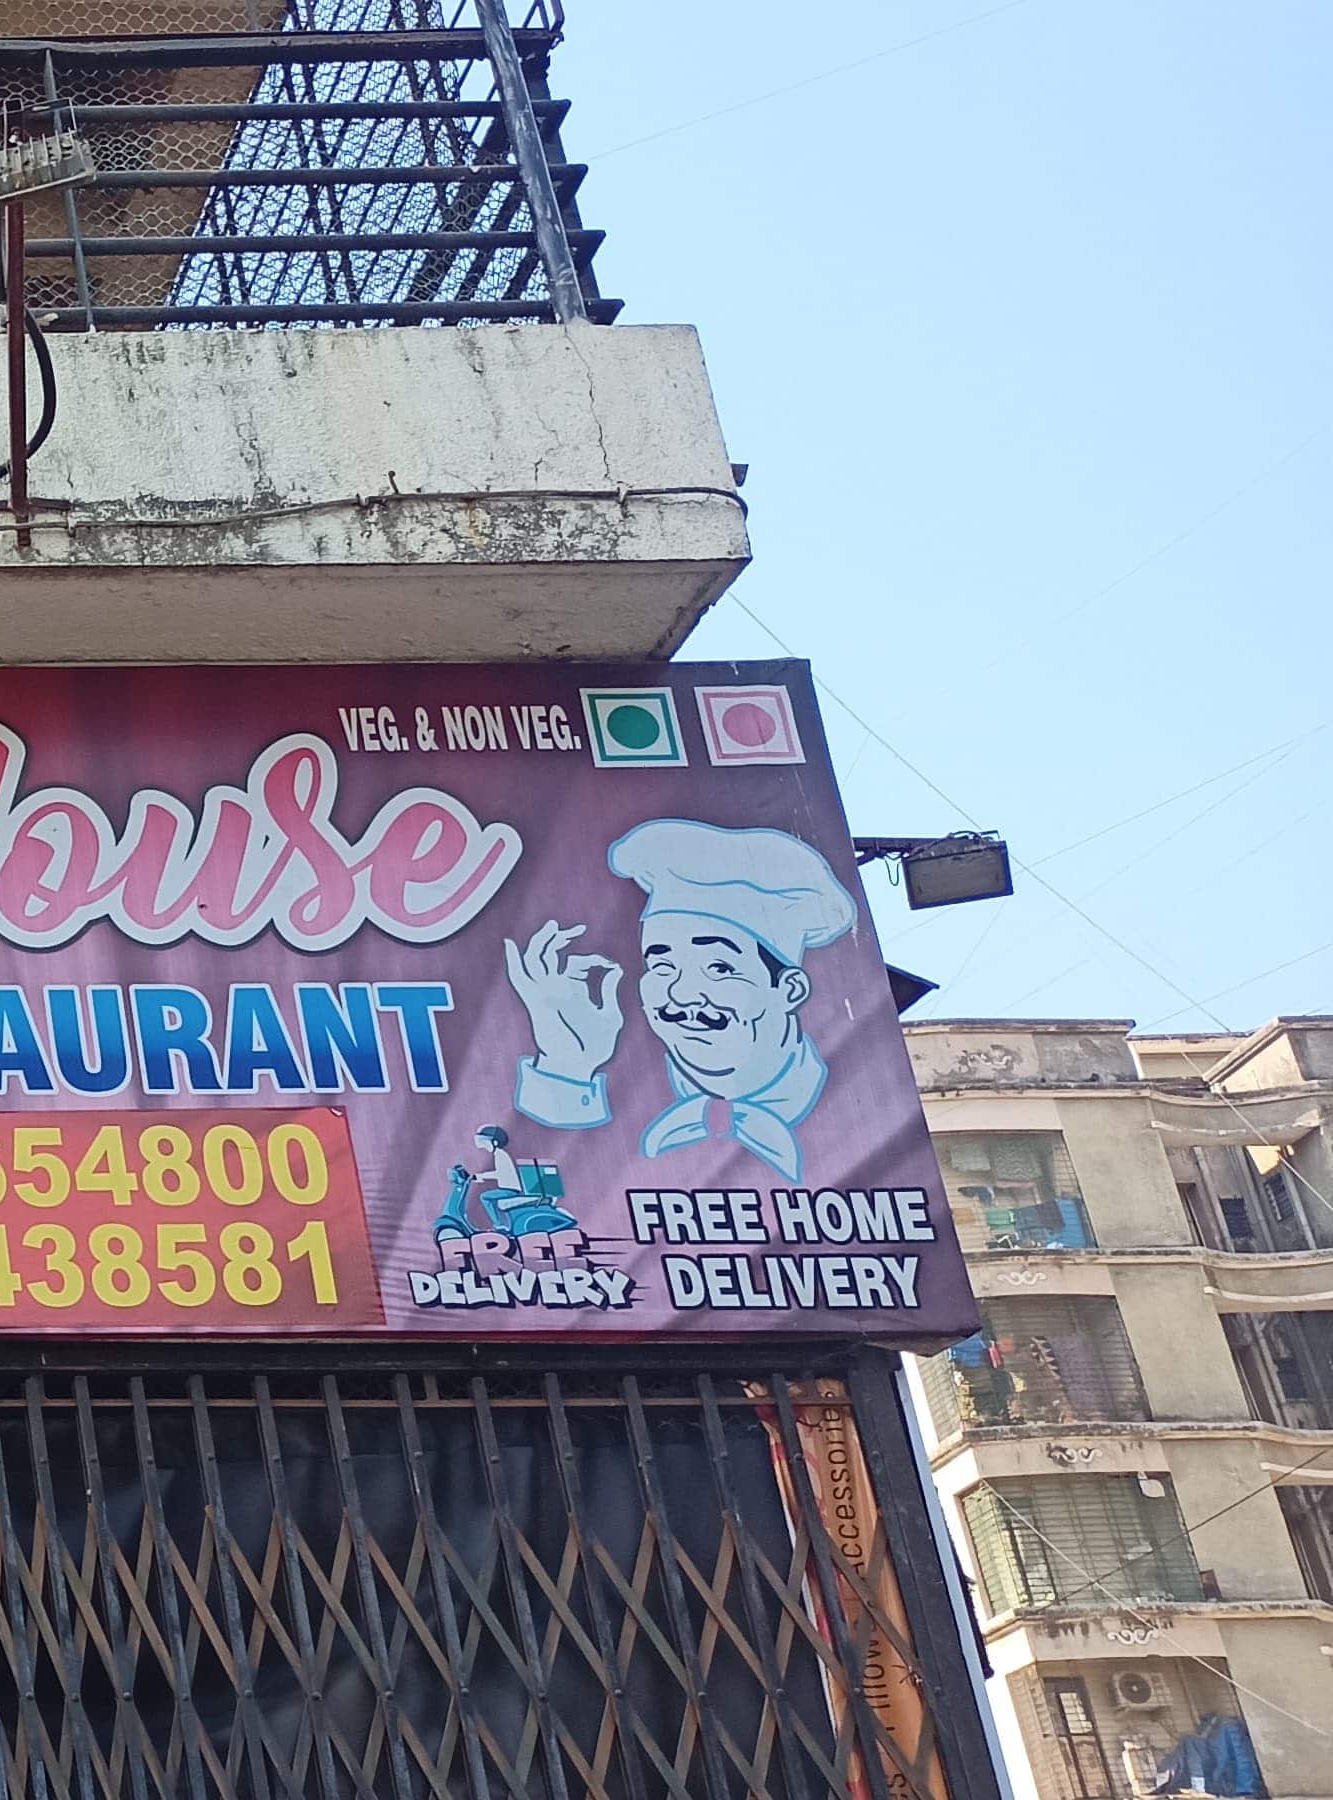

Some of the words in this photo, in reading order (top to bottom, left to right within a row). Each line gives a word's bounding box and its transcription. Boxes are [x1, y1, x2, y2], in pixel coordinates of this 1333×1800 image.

[338, 706, 409, 751] VEG.
[415, 707, 439, 750] &
[441, 705, 508, 750] NON
[510, 705, 582, 750] VEG.
[625, 1190, 767, 1245] FREE
[779, 1189, 936, 1244] HOME
[440, 1229, 591, 1274] FREE
[408, 1268, 636, 1310] DELIVERY
[661, 1255, 925, 1309] DELIVERY
